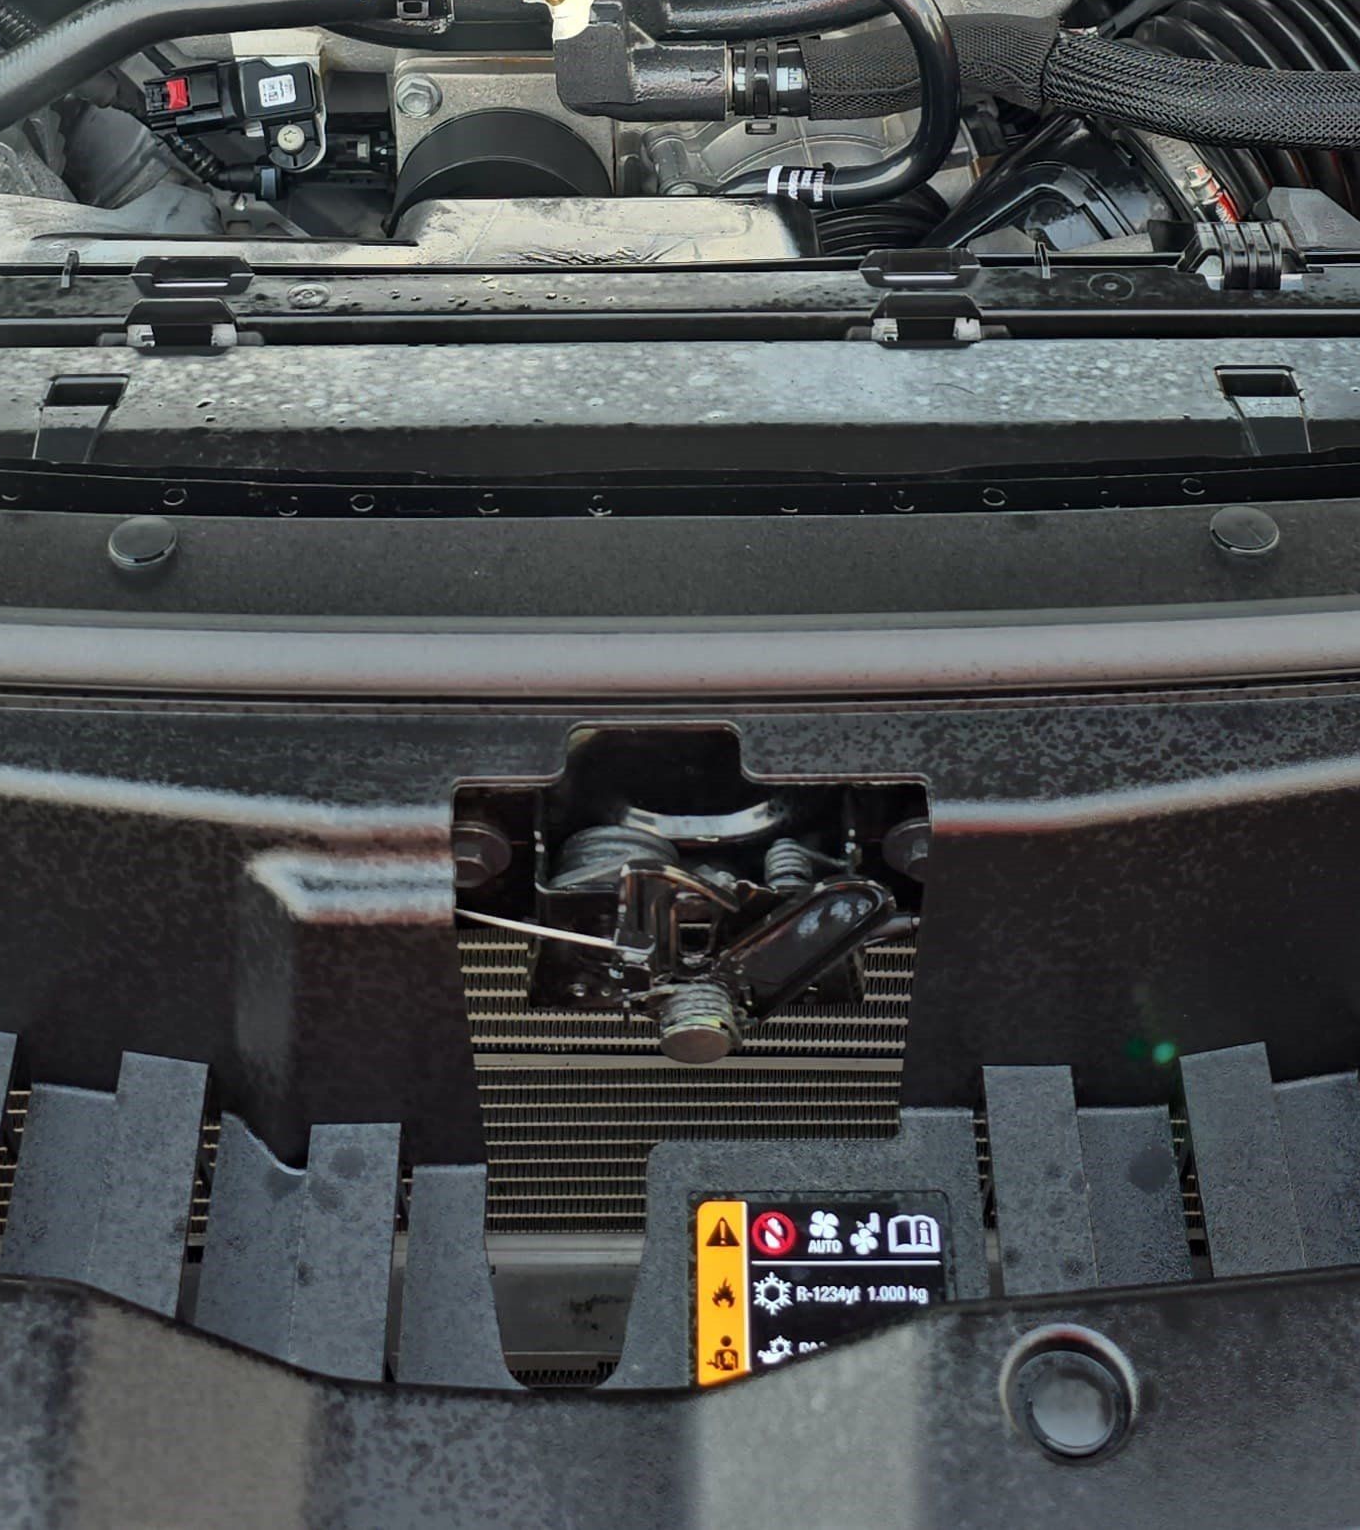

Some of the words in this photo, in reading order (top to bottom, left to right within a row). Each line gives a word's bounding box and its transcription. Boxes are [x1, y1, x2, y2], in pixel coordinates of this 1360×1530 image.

[808, 1240, 843, 1254] AUTO
[796, 1285, 861, 1305] R-1234yf
[867, 1285, 906, 1302] 1.000
[909, 1285, 929, 1304] kg
